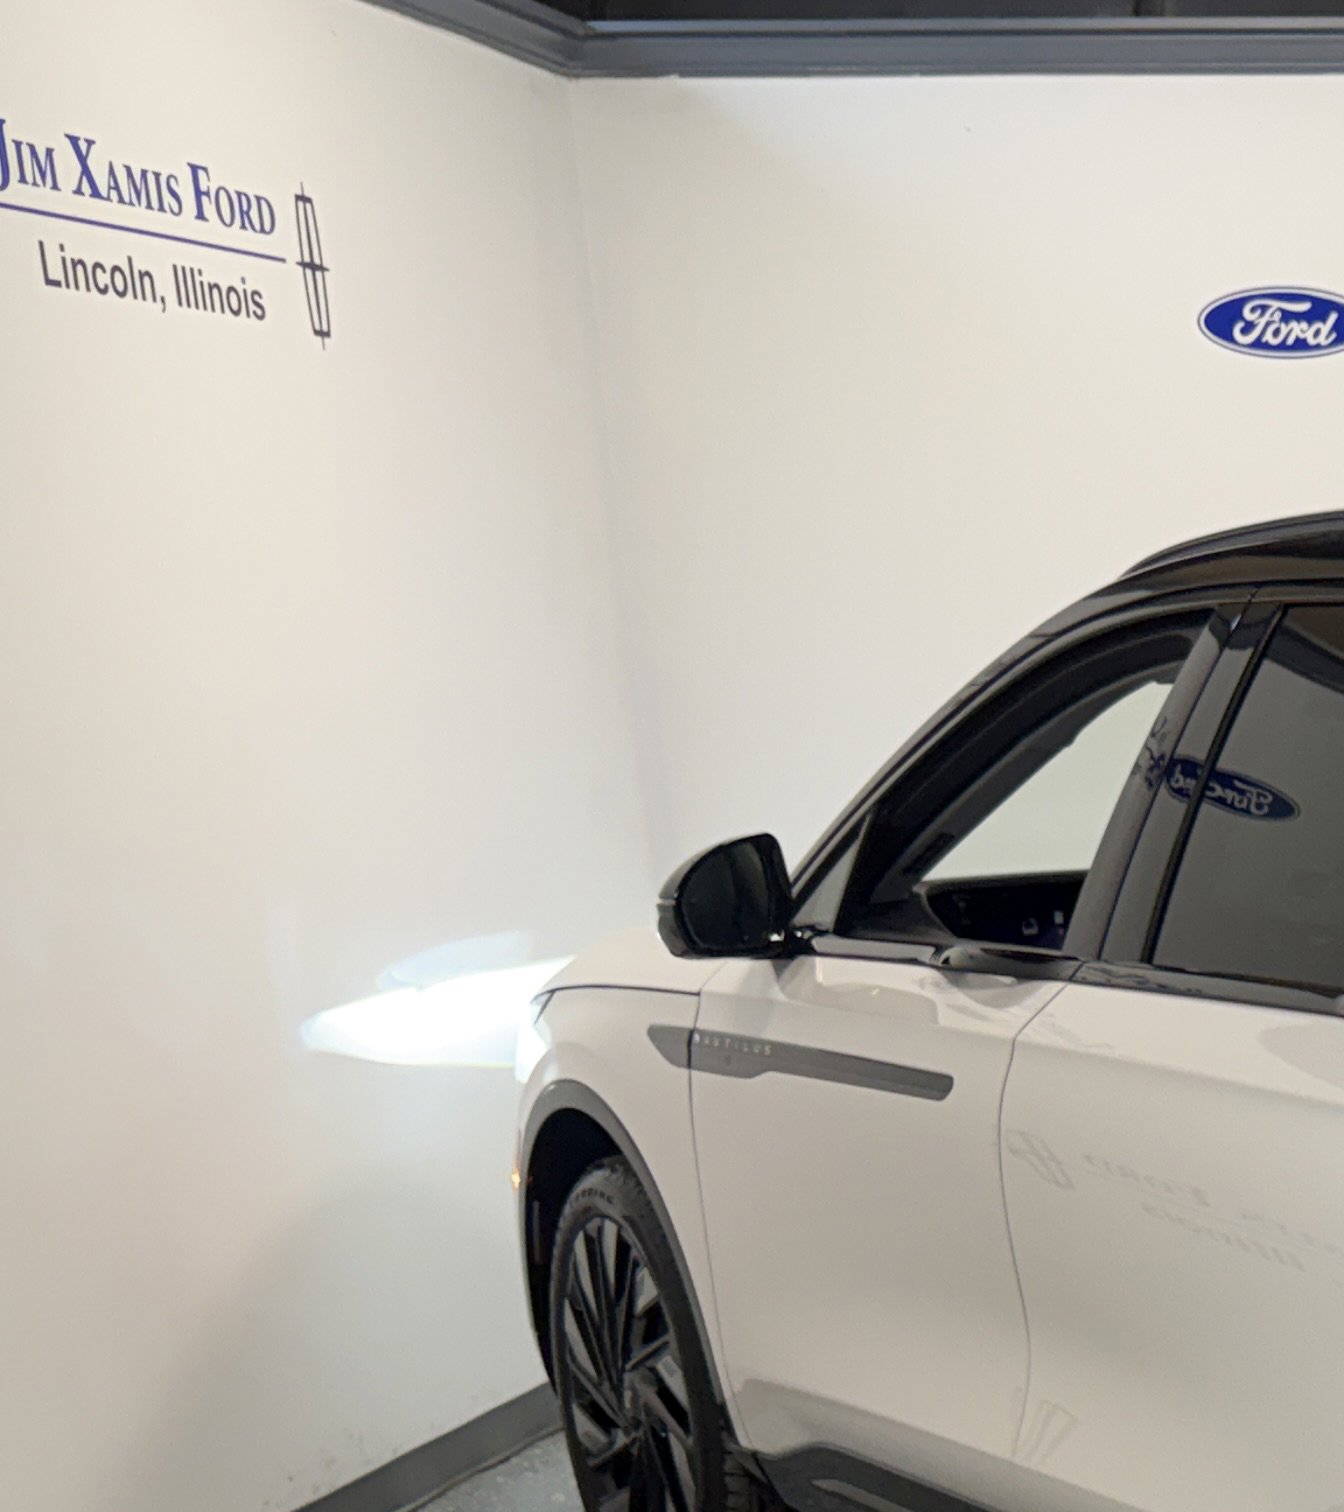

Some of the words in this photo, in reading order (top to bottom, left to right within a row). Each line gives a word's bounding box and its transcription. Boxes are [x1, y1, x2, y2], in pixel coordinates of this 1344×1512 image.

[64, 133, 183, 217] XAMIS
[187, 162, 276, 235] FORD
[38, 239, 167, 313] Lincoln,
[172, 263, 266, 321] Illinois
[1231, 298, 1338, 346] Ford
